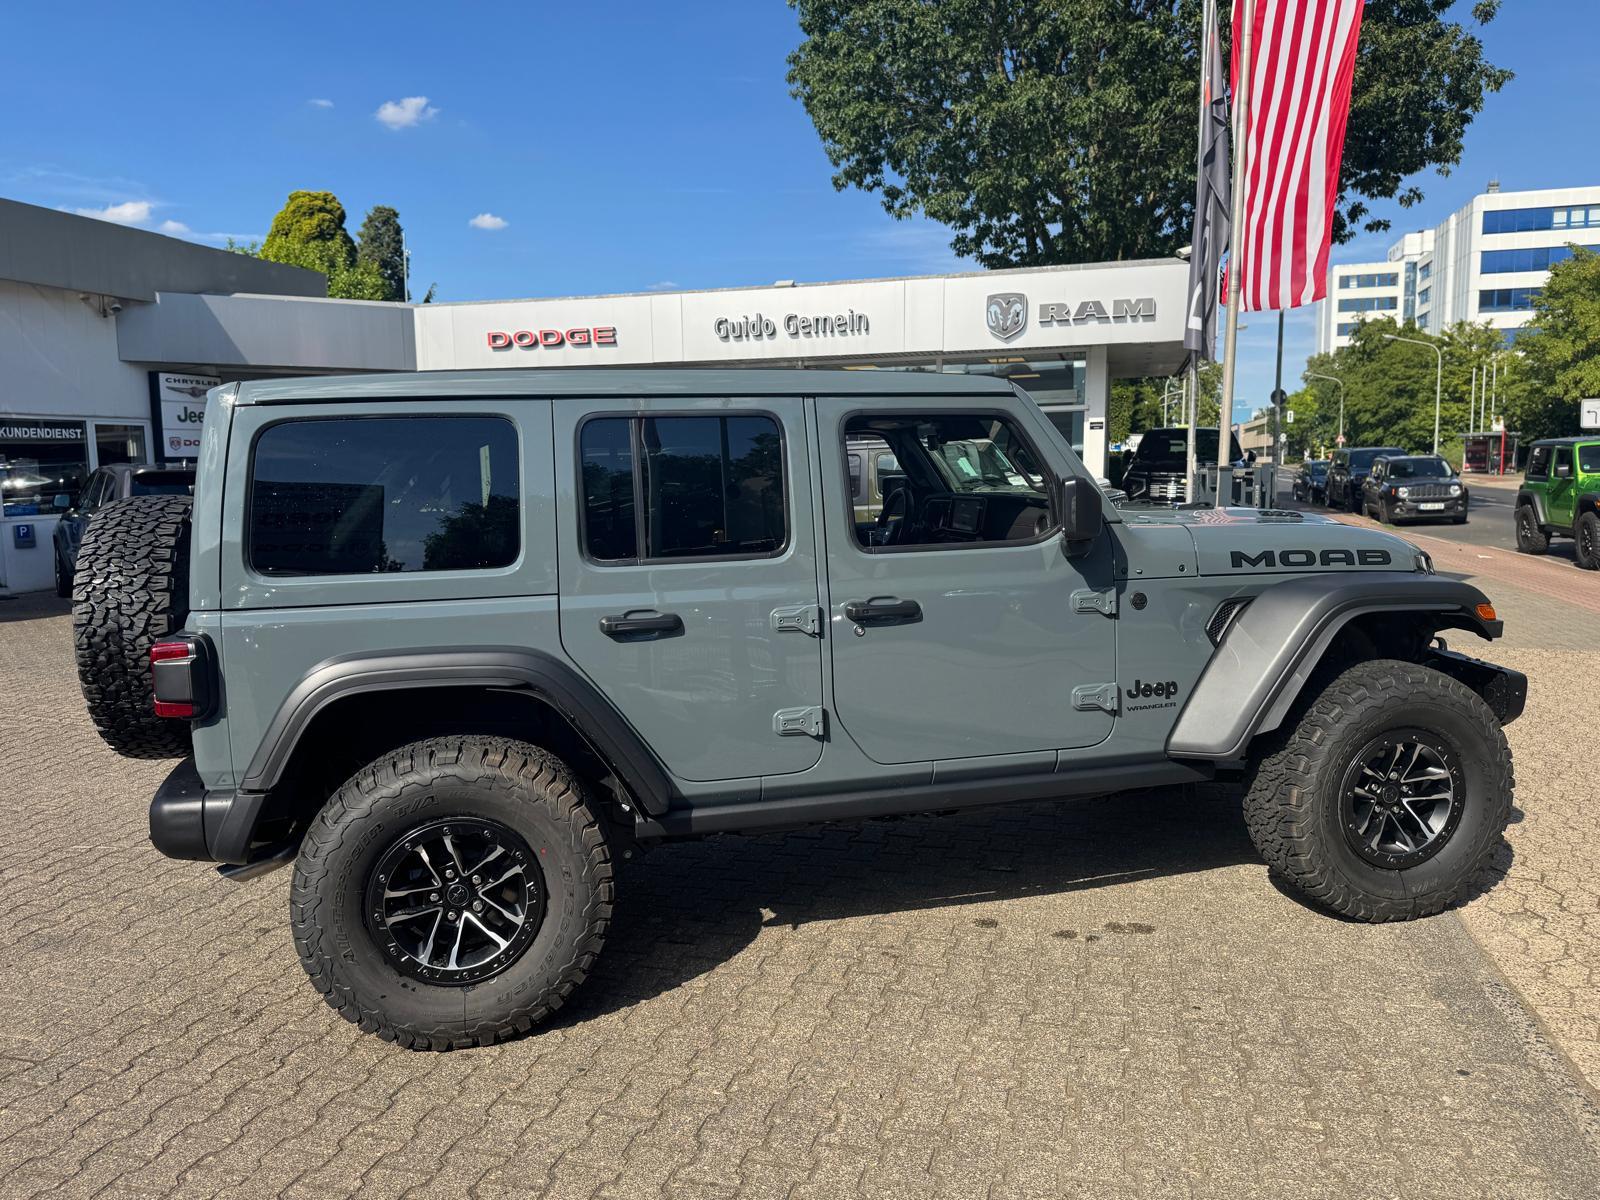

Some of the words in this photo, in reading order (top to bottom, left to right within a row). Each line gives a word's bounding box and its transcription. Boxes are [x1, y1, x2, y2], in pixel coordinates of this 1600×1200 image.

[1039, 297, 1156, 323] RAM
[714, 312, 776, 342] Guido
[784, 309, 870, 338] Gemein
[487, 326, 618, 350] DODGE
[165, 377, 220, 387] CHRYSLER
[177, 406, 205, 423] Jee
[0, 426, 82, 439] KUNDENDIENST
[20, 526, 28, 537] P
[1230, 549, 1392, 568] MOAB
[1126, 679, 1178, 700] Jeep
[1126, 702, 1177, 712] WRANGLER
